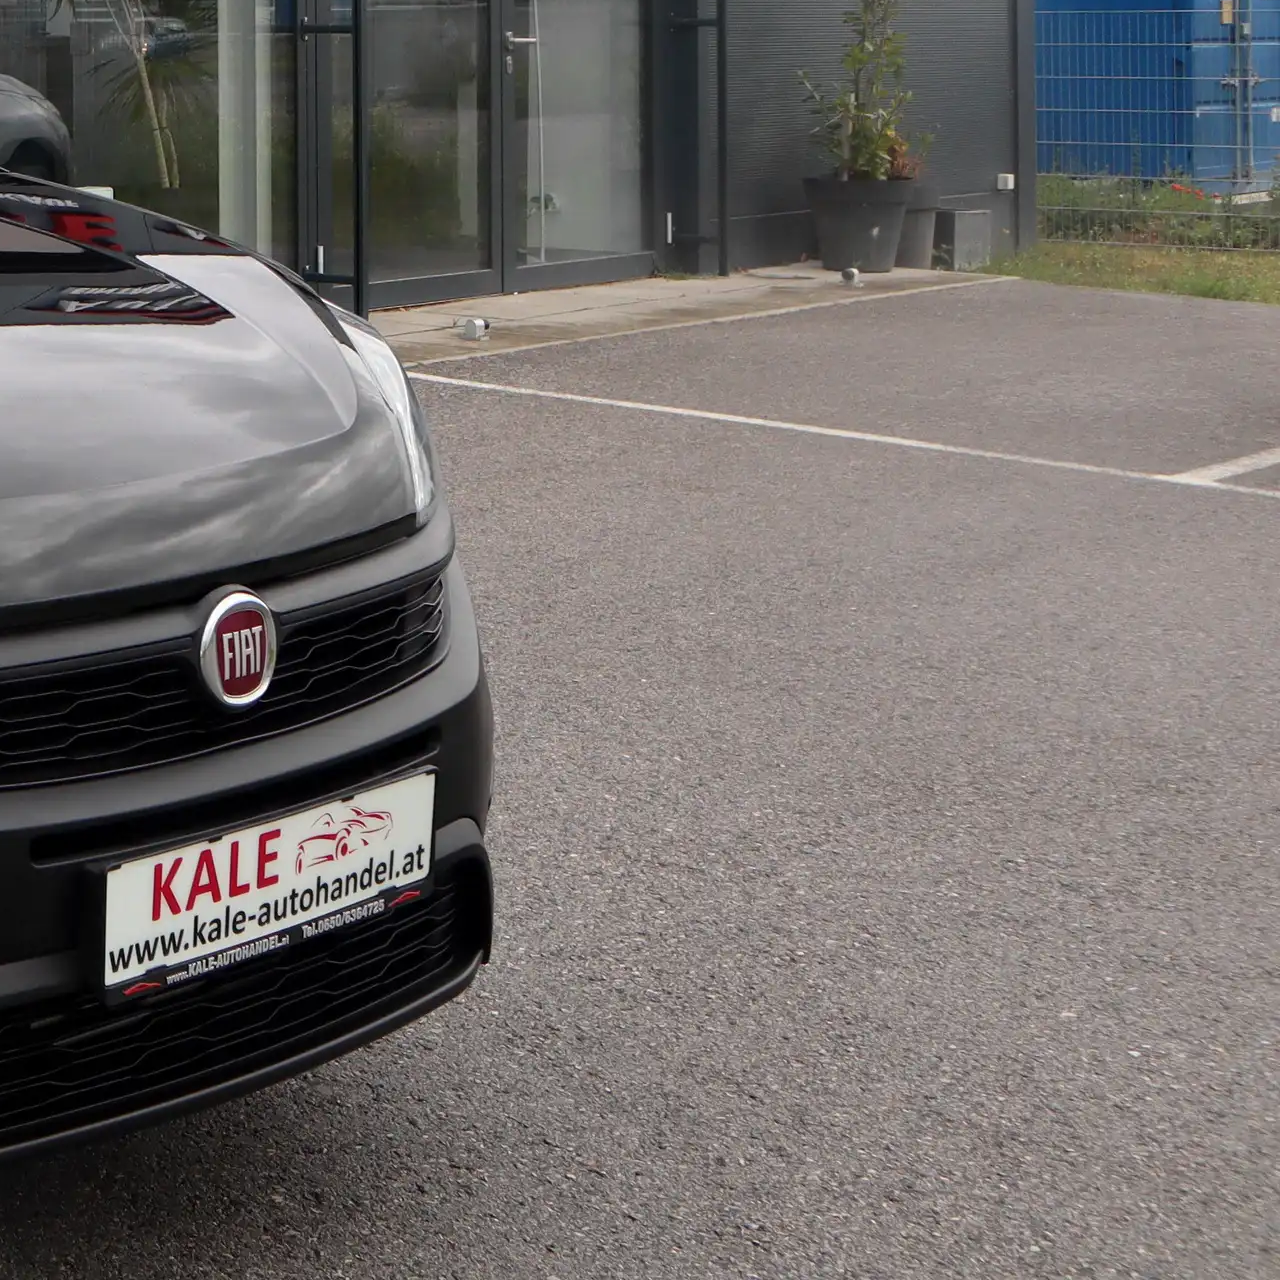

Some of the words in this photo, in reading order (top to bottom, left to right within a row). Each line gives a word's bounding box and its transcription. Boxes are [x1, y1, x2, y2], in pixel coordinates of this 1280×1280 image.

[222, 625, 266, 681] FIAT
[110, 844, 425, 974] www.kale-autohandel.at
[152, 828, 282, 921] KALE
